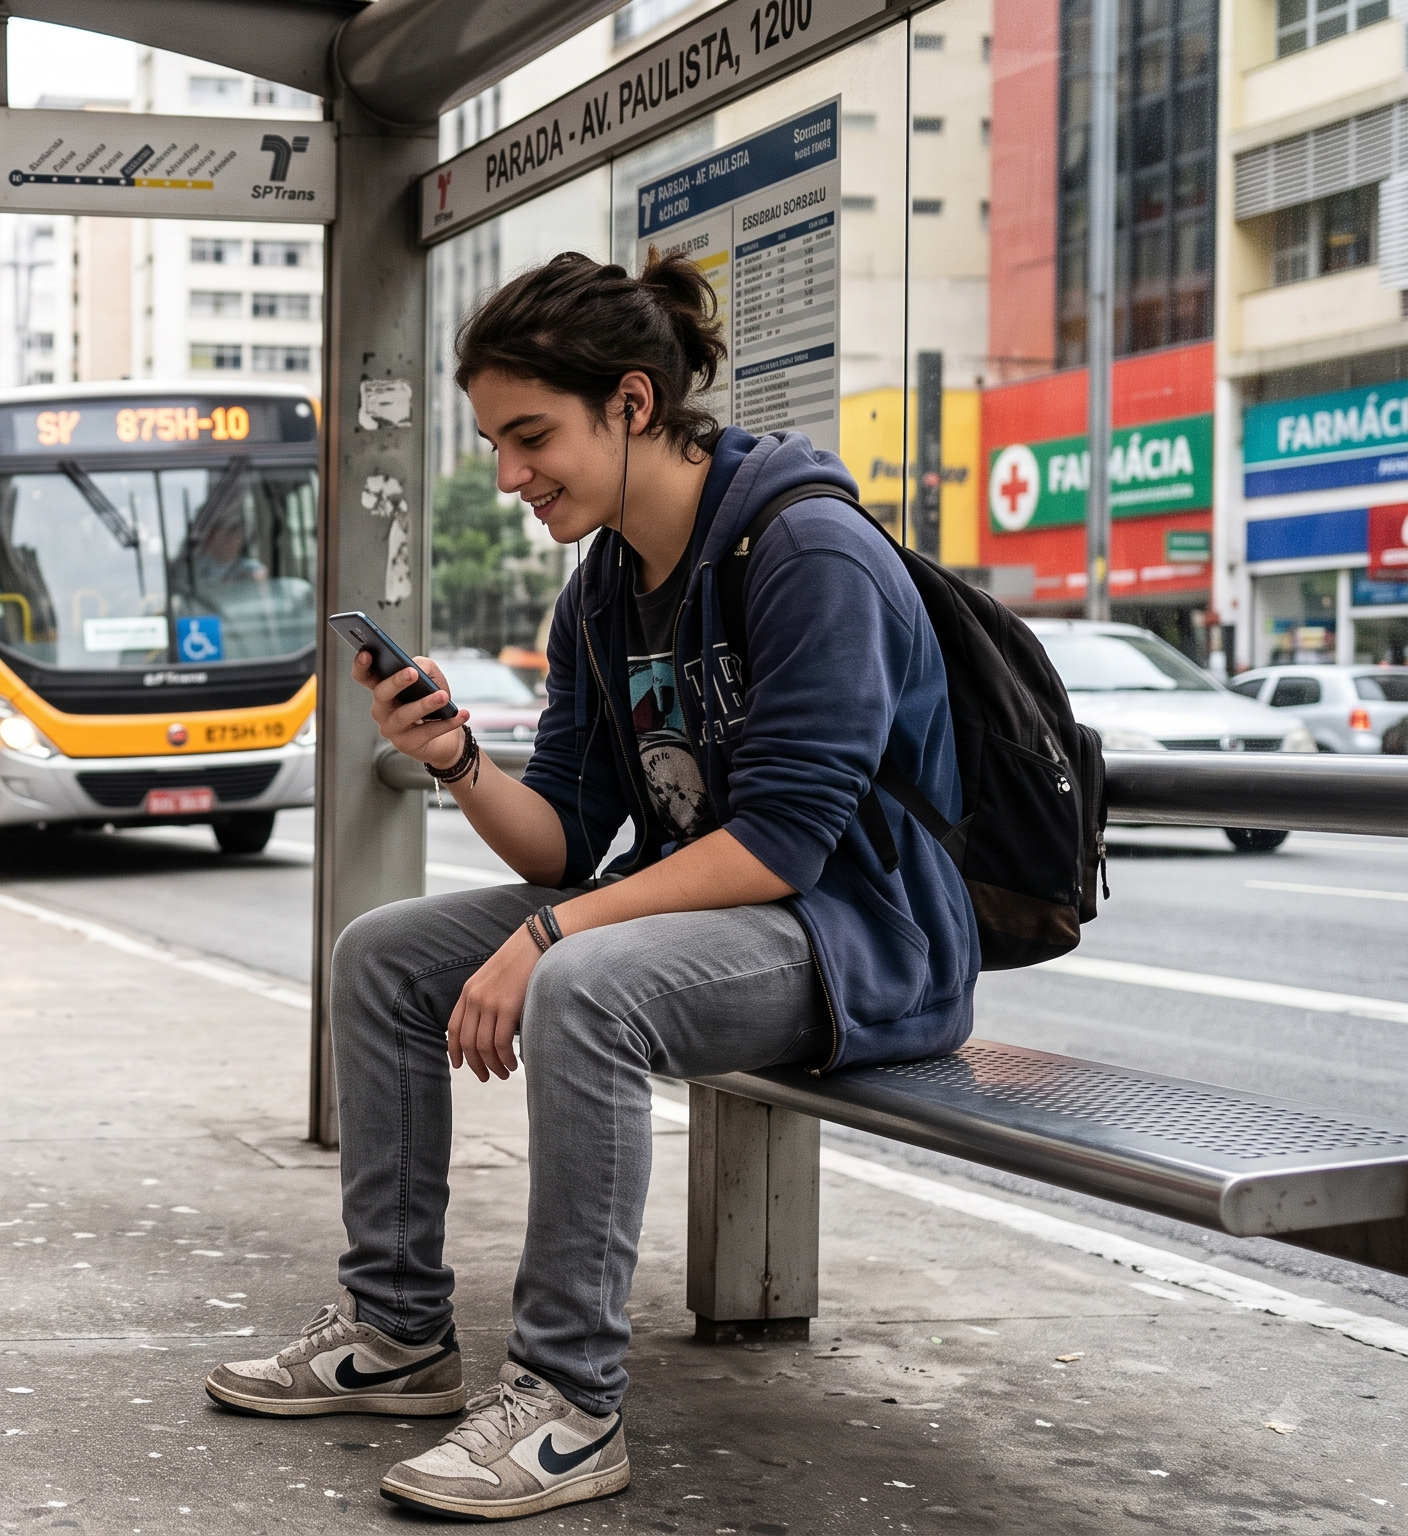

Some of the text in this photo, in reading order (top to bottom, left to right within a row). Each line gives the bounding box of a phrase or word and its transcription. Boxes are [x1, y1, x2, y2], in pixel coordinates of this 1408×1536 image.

[486, 118, 564, 192] PARADA
[580, 91, 612, 145] AV.
[619, 26, 741, 124] PAULISTA,
[750, 0, 812, 55] 1200
[251, 184, 315, 201] SPTrans
[116, 406, 250, 443] 875H-10
[1277, 391, 1408, 453] FARMÁCI
